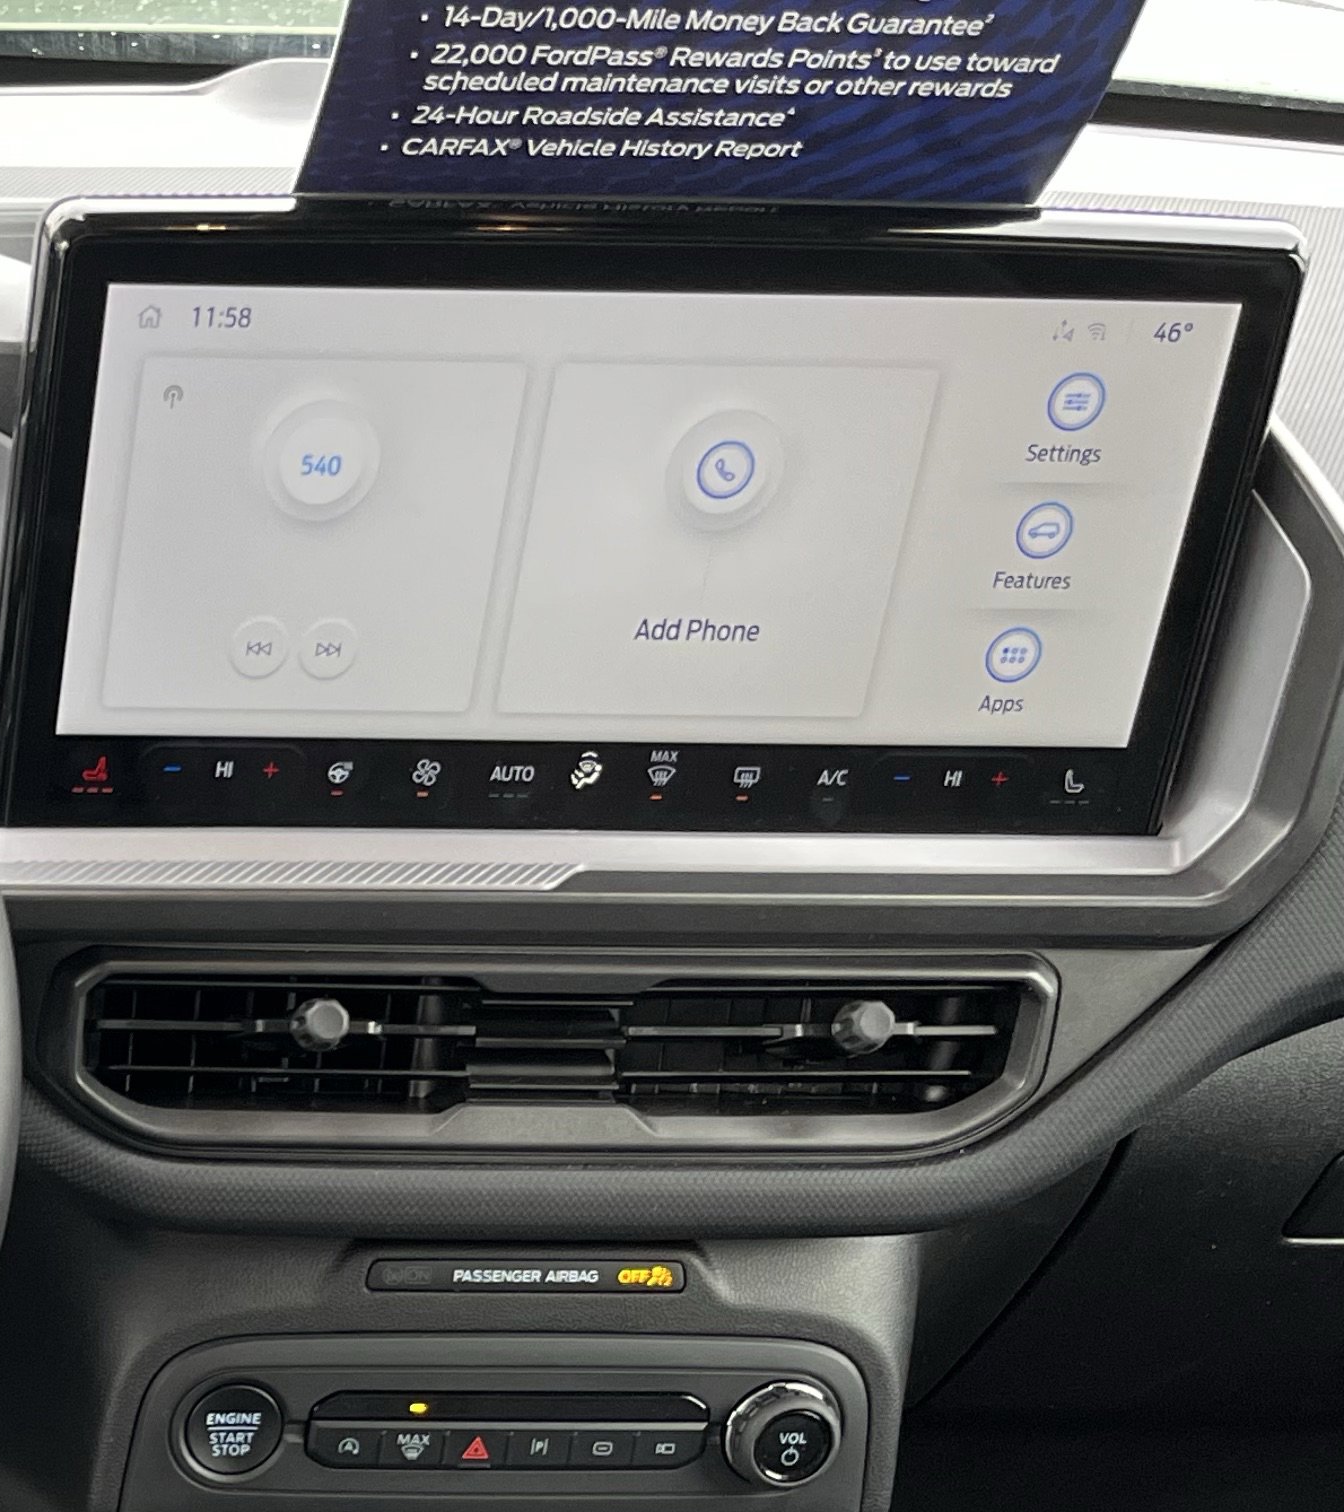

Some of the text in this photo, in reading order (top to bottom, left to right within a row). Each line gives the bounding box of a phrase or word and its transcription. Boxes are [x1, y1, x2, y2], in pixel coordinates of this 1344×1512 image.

[444, 5, 681, 31] 14-Day/1,000-Mile
[685, 9, 774, 35] Money
[777, 11, 843, 34] Back
[430, 44, 527, 67] 22,000
[669, 46, 783, 70] Rewards
[883, 52, 911, 71] to
[915, 55, 961, 72] use
[966, 53, 1061, 74] toward
[423, 72, 1013, 99] scheduled maintenance visits or other rewards
[411, 105, 519, 126] 24-Hour
[521, 106, 642, 127] Roadside
[526, 138, 617, 158] Vehicle
[619, 139, 714, 161] History
[714, 140, 803, 161] Report
[192, 306, 252, 329] 11:58
[1153, 322, 1194, 344] 46°
[1025, 443, 1102, 466] Settings
[300, 455, 343, 477] 540
[992, 570, 1072, 591] Features
[634, 619, 760, 643] Add Phone
[978, 694, 1024, 715] Apps
[649, 751, 680, 763] MAX
[215, 761, 233, 778] HI
[490, 765, 535, 783] AUTO
[817, 769, 848, 786] A/C
[944, 769, 962, 788] HI
[452, 1268, 541, 1283] PASSENGER
[544, 1269, 599, 1284] AIRBAG
[617, 1268, 651, 1284] OFF
[206, 1412, 262, 1425] ENGINE
[209, 1432, 255, 1444] START
[397, 1433, 431, 1446] MAX
[779, 1432, 808, 1445] VOL
[212, 1444, 251, 1457] STOP
